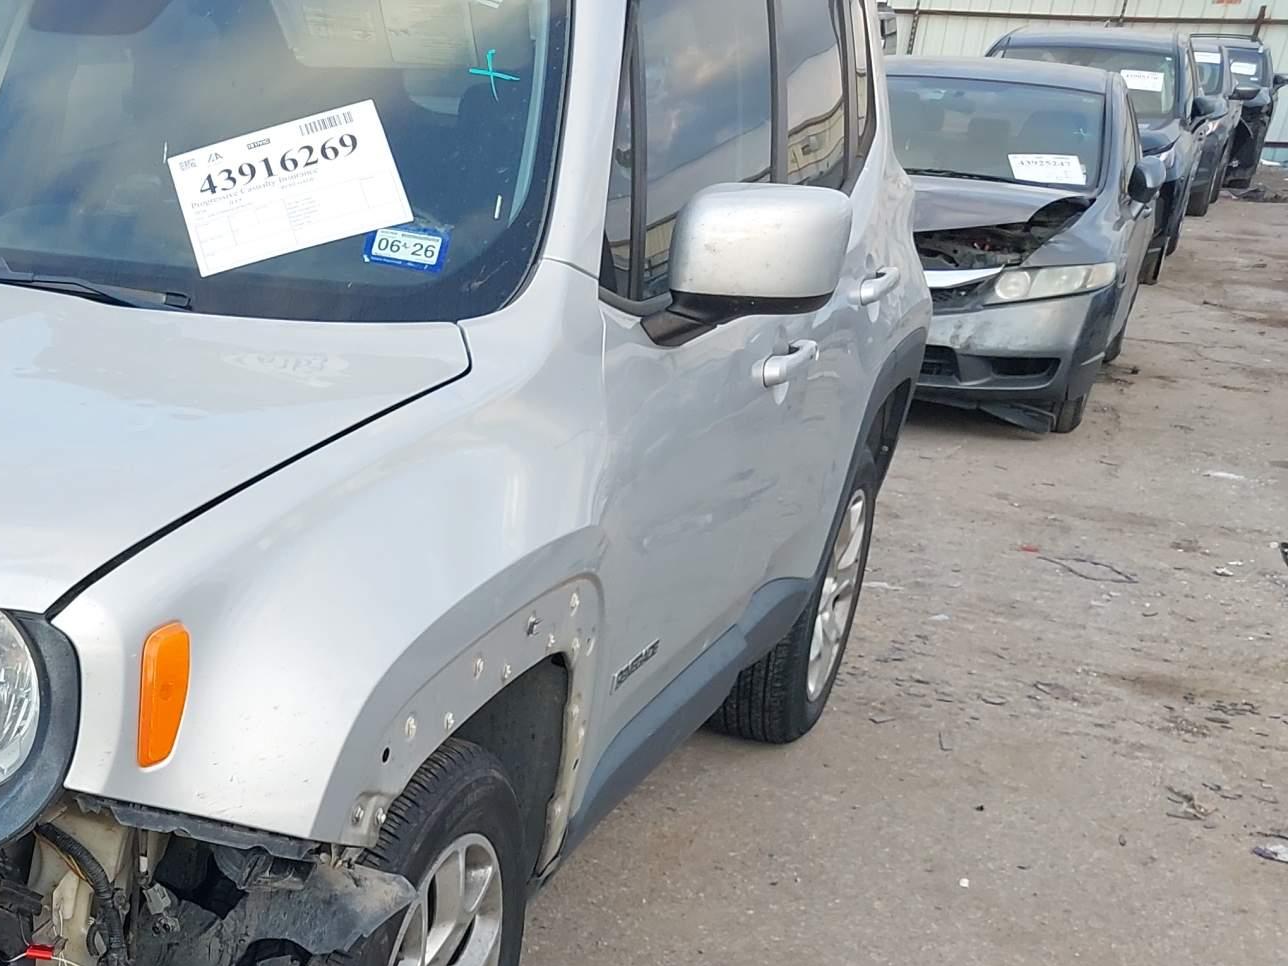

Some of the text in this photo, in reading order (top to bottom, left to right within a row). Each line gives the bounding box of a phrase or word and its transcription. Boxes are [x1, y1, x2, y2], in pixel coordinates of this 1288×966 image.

[199, 133, 358, 195] 43916269
[377, 237, 437, 259] 06 26
